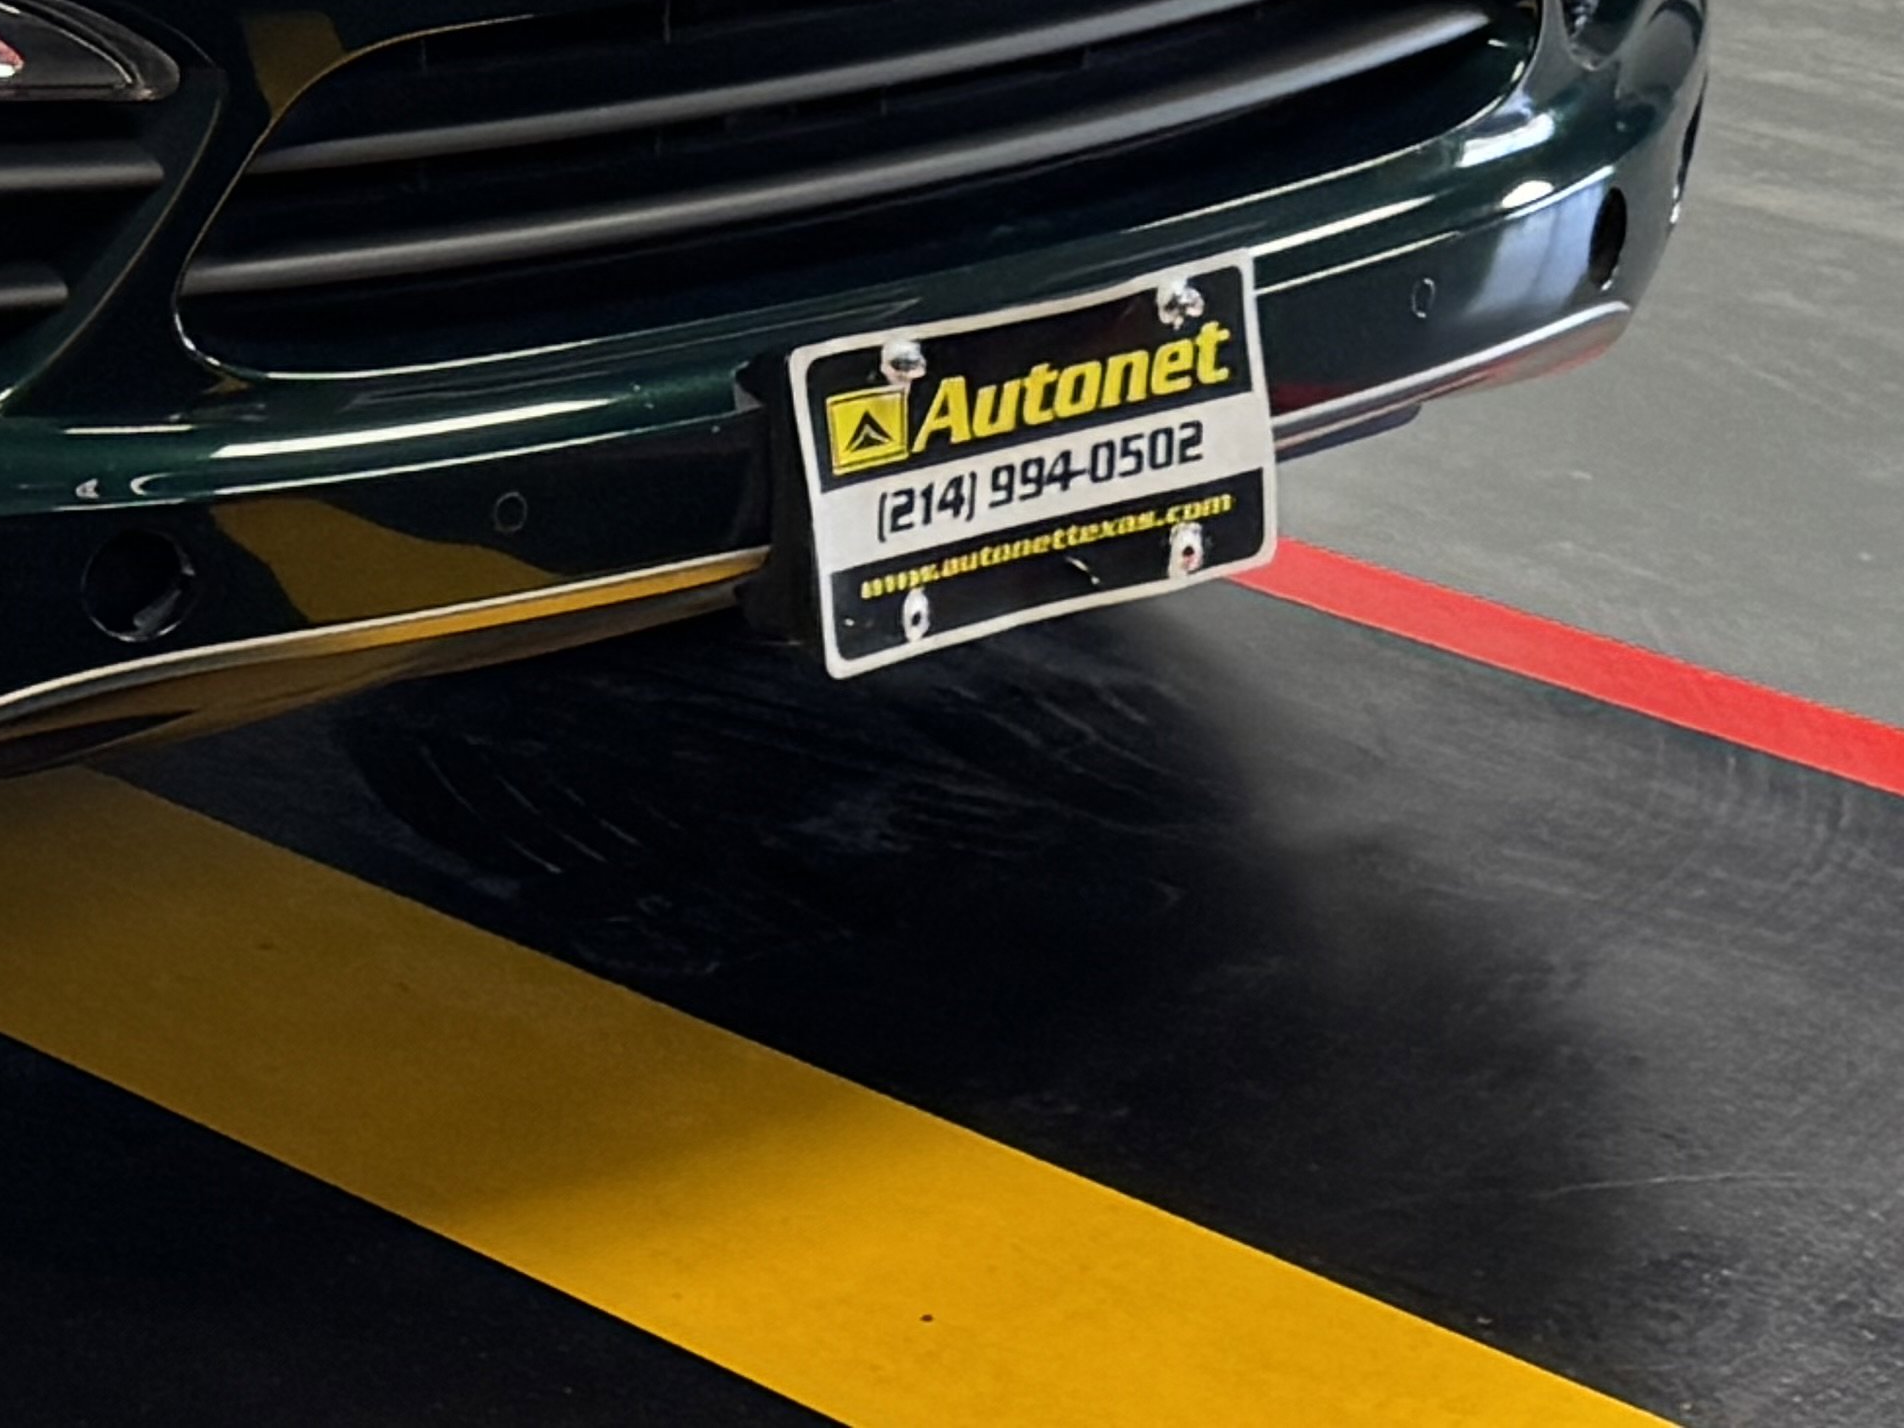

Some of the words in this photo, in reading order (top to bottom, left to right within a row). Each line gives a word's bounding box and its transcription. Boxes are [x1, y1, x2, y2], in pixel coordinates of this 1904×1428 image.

[910, 320, 1232, 453] Autonet
[877, 470, 978, 542] (214)
[988, 420, 1204, 508] 994-0502
